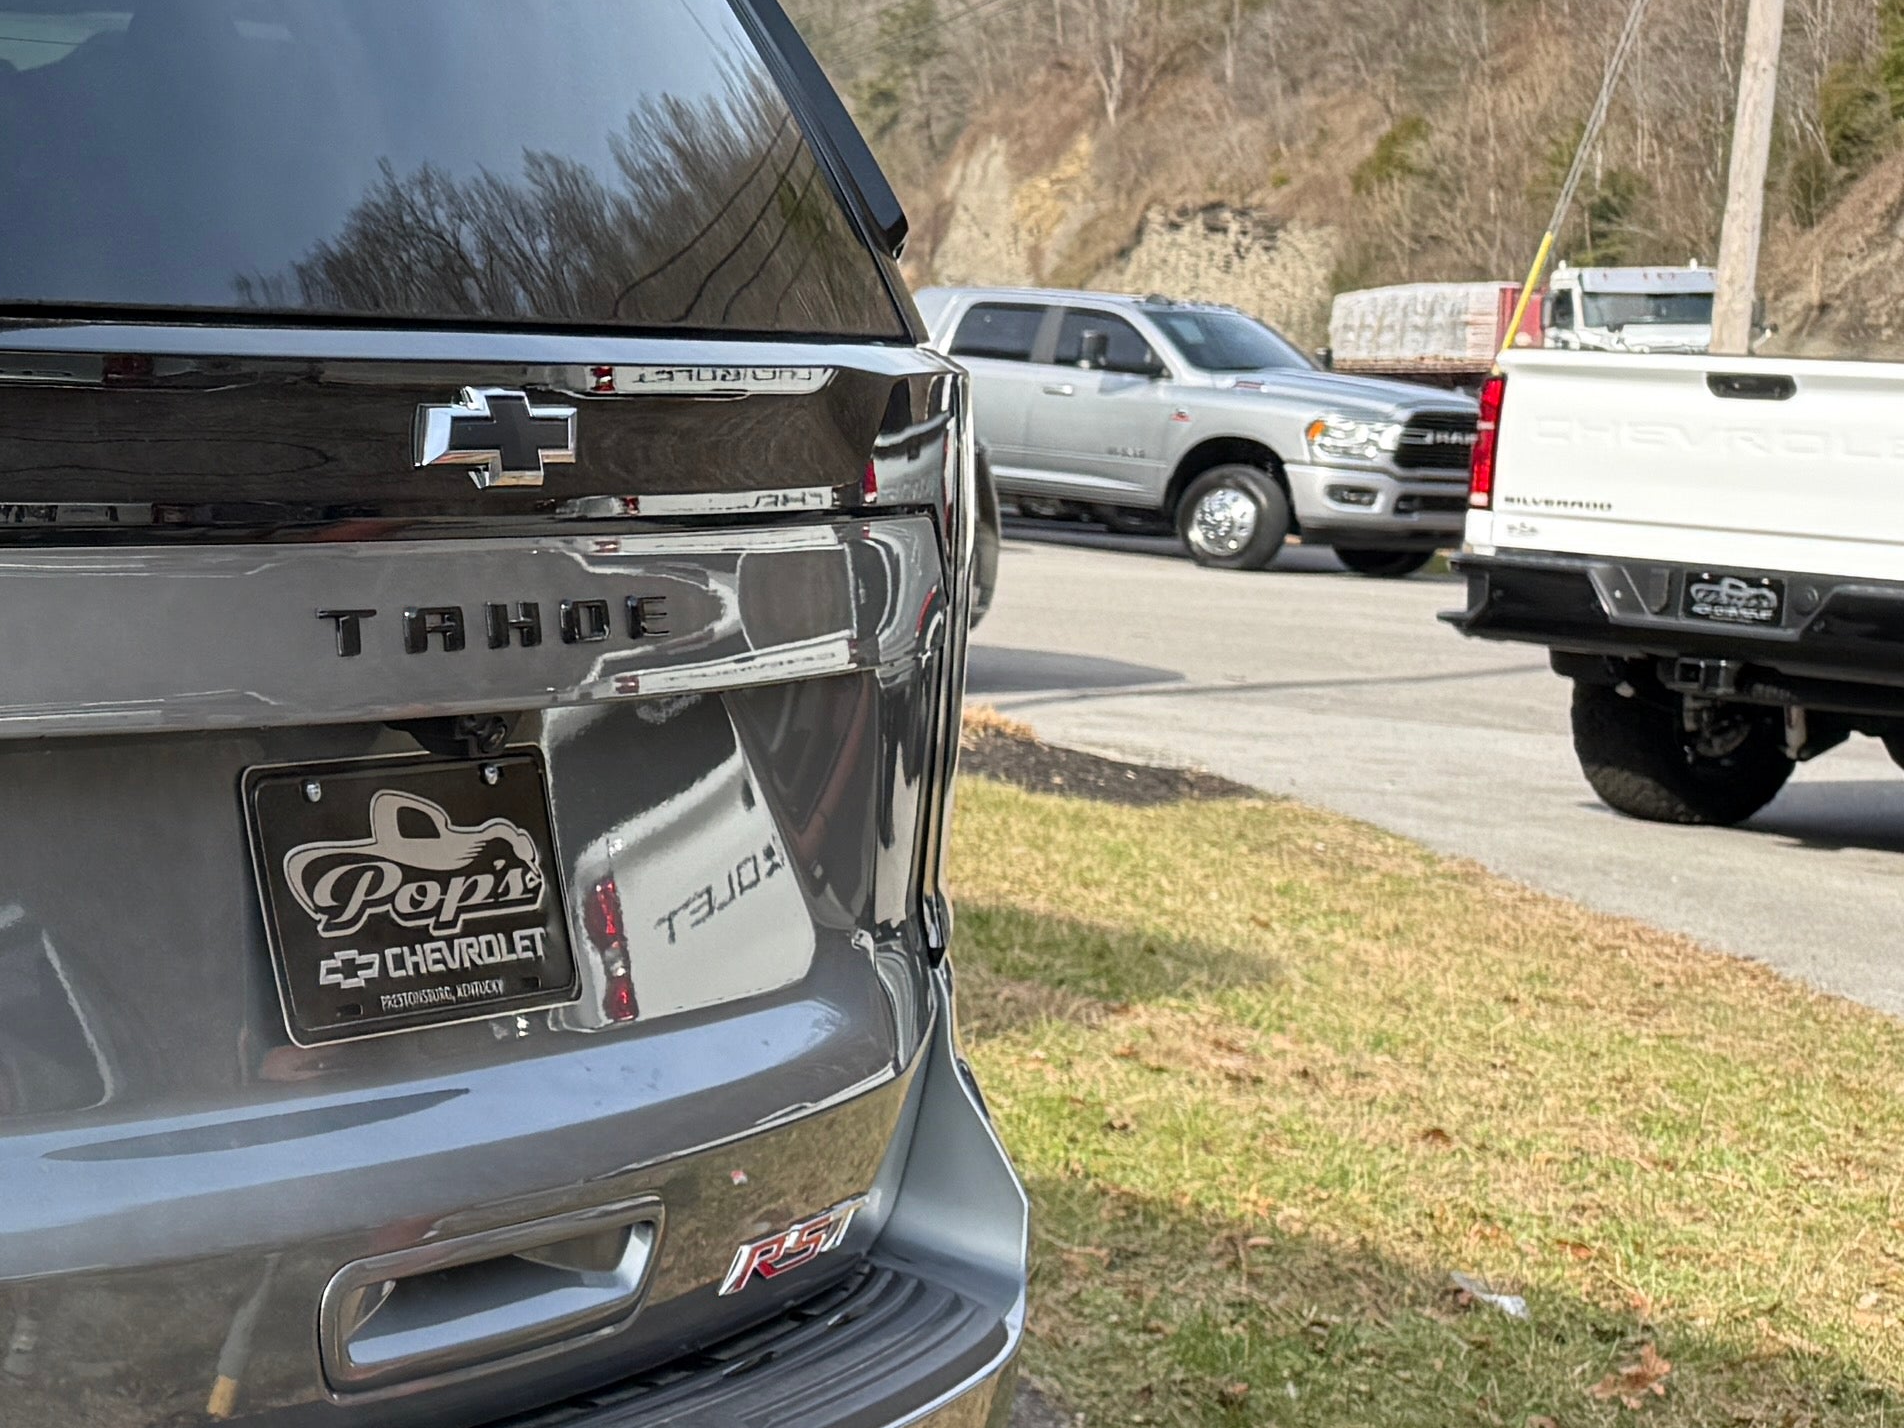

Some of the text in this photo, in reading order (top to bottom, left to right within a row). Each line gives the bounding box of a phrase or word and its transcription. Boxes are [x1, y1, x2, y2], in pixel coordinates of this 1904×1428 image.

[315, 594, 672, 657] TAHOE
[312, 860, 530, 925] Pop's
[384, 926, 548, 978] CHEVROLET
[718, 1192, 870, 1295] RST
